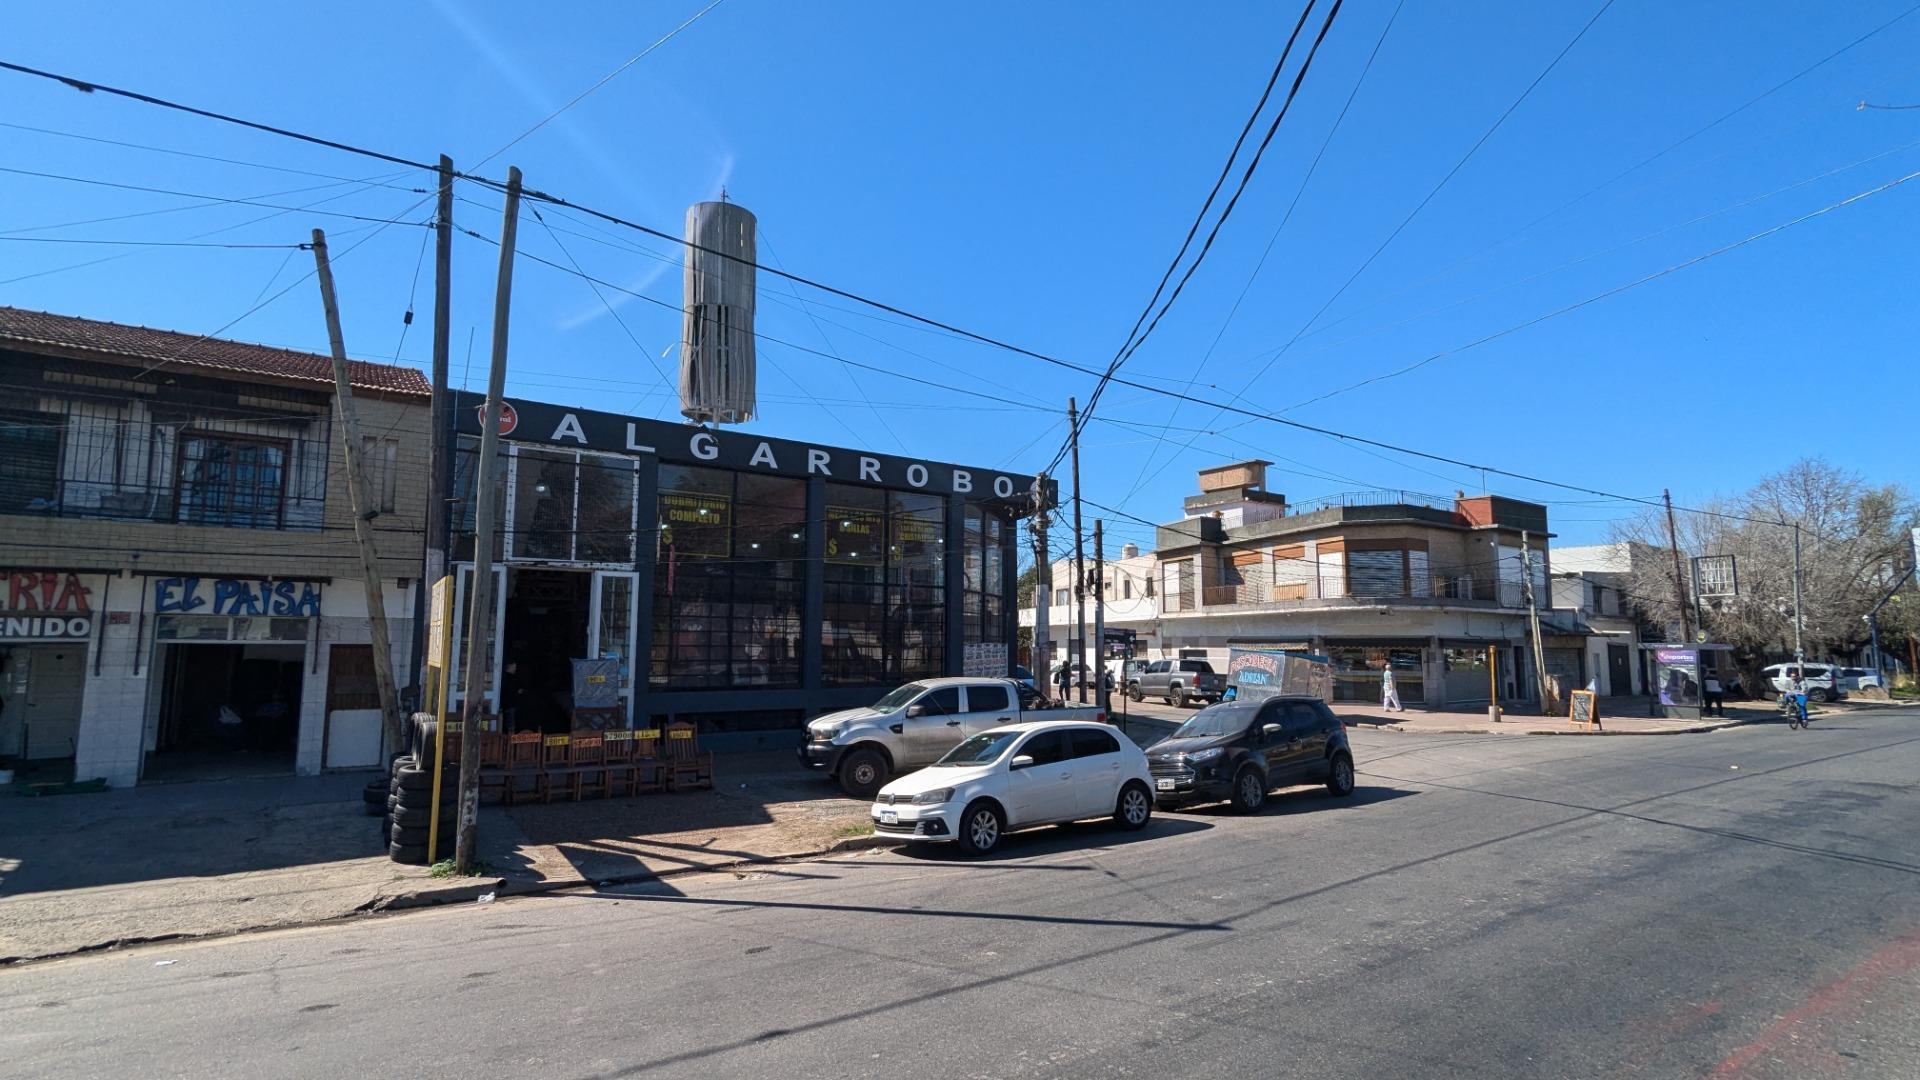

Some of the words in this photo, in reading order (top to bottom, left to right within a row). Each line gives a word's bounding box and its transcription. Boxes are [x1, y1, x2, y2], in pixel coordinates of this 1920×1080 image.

[550, 413, 1014, 498] ALGARROBO
[0, 569, 92, 612] RIA
[155, 577, 206, 612] EL
[0, 617, 91, 637] NIDO
